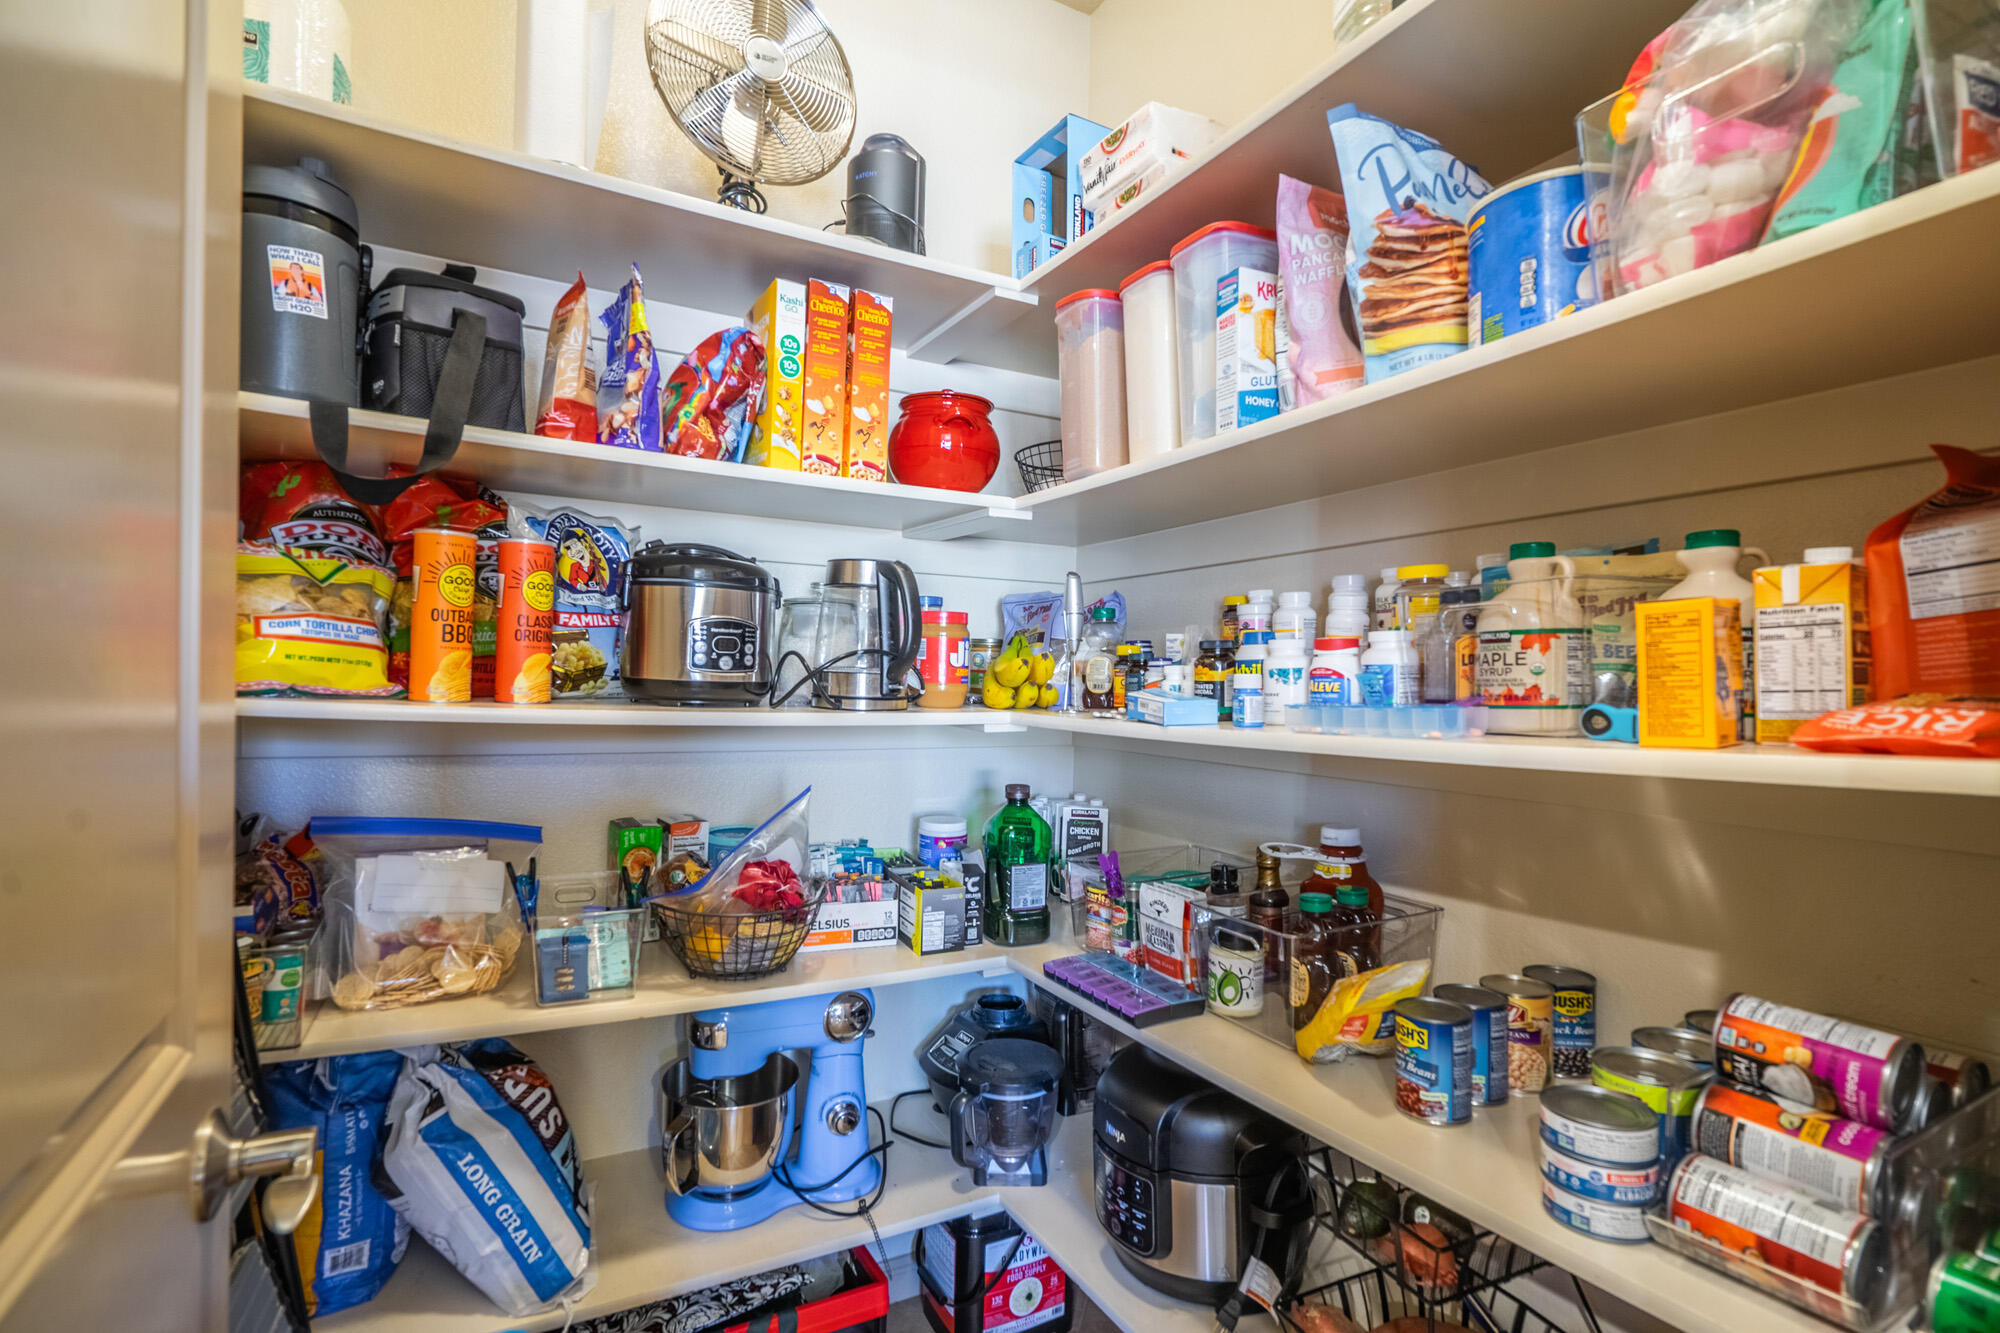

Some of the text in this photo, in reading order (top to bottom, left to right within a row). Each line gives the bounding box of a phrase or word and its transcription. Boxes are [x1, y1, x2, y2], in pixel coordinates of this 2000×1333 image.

[1039, 174, 1047, 220] FREEZER
[302, 257, 321, 266] CALL
[1292, 252, 1346, 270] PANCA
[1294, 265, 1344, 286] WAFFL
[779, 293, 804, 307] Kashi
[290, 303, 313, 313] H2O
[810, 299, 845, 317] Cheerios
[856, 309, 889, 326] Cheerios
[1245, 396, 1276, 408] HONEY
[313, 509, 367, 526] AUTHENTIC
[431, 608, 473, 623] OUTBA
[1760, 607, 1806, 615] Nutrition
[268, 619, 301, 628] CORN
[304, 619, 353, 633] TORTILLA
[559, 613, 611, 627] FAMILY
[1480, 668, 1512, 677] SYRUP
[1310, 681, 1341, 692] ALEVE
[1822, 710, 1979, 733] RICE
[1069, 827, 1100, 836] CHICKEN
[884, 911, 893, 920] 12
[811, 918, 850, 930] ELSIUS
[1508, 1031, 1530, 1039] EANS
[1844, 1061, 1862, 1103] cream
[1105, 1120, 1126, 1143] NINJA
[337, 1164, 352, 1240] KHAZANA
[457, 1152, 543, 1265] LONG GRAIN
[1001, 1245, 1047, 1267] RADYWI
[1006, 1263, 1047, 1285] FOOD SUPPLY
